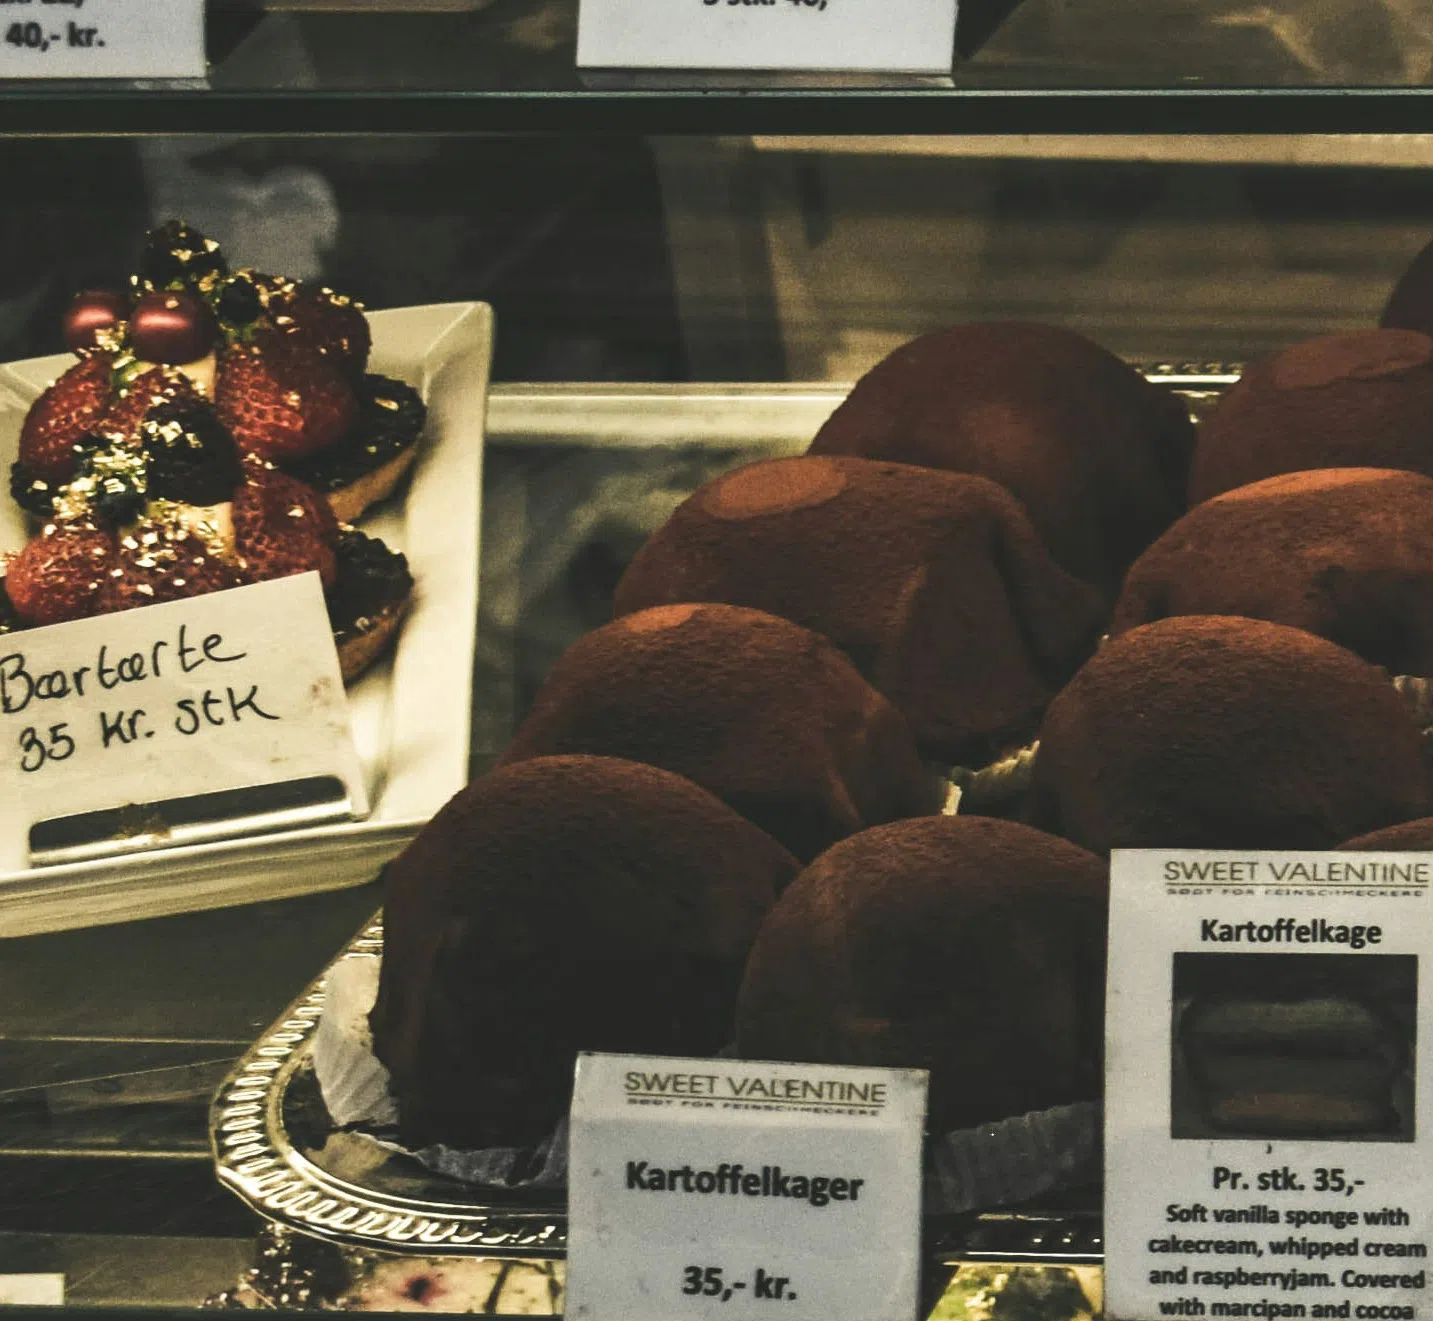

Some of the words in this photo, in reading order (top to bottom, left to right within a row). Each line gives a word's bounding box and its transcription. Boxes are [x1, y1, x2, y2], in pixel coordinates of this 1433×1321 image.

[5, 21, 61, 52] 40,-
[67, 21, 105, 47] kr.
[20, 722, 75, 772] 35
[1164, 861, 1259, 881] SWEET
[1268, 863, 1429, 883] VALENTINE
[1201, 918, 1382, 949] Kartoffelkage
[624, 1071, 719, 1094] SWEET
[727, 1076, 886, 1103] VALENTINE
[626, 1161, 864, 1207] Kartoffelkager
[1213, 1167, 1249, 1191] Pr.
[1257, 1167, 1305, 1192] stk.
[1312, 1168, 1365, 1197] 35,-
[1166, 1204, 1208, 1224] Soft
[1214, 1205, 1280, 1225] vanilla
[1283, 1208, 1359, 1230] sponge
[1363, 1207, 1409, 1227] with
[1148, 1238, 1263, 1258] cakecream,
[1269, 1238, 1359, 1260] whipped
[1363, 1241, 1427, 1258] cream
[683, 1265, 746, 1302] 35,-
[754, 1268, 797, 1300] kr.
[1149, 1267, 1187, 1286] and
[1193, 1268, 1336, 1290] raspberryjam.
[1341, 1270, 1425, 1290] Covered
[1160, 1299, 1204, 1317] with
[1210, 1301, 1306, 1321] marcipan
[1311, 1301, 1351, 1320] and
[1356, 1305, 1414, 1321] cocoa
